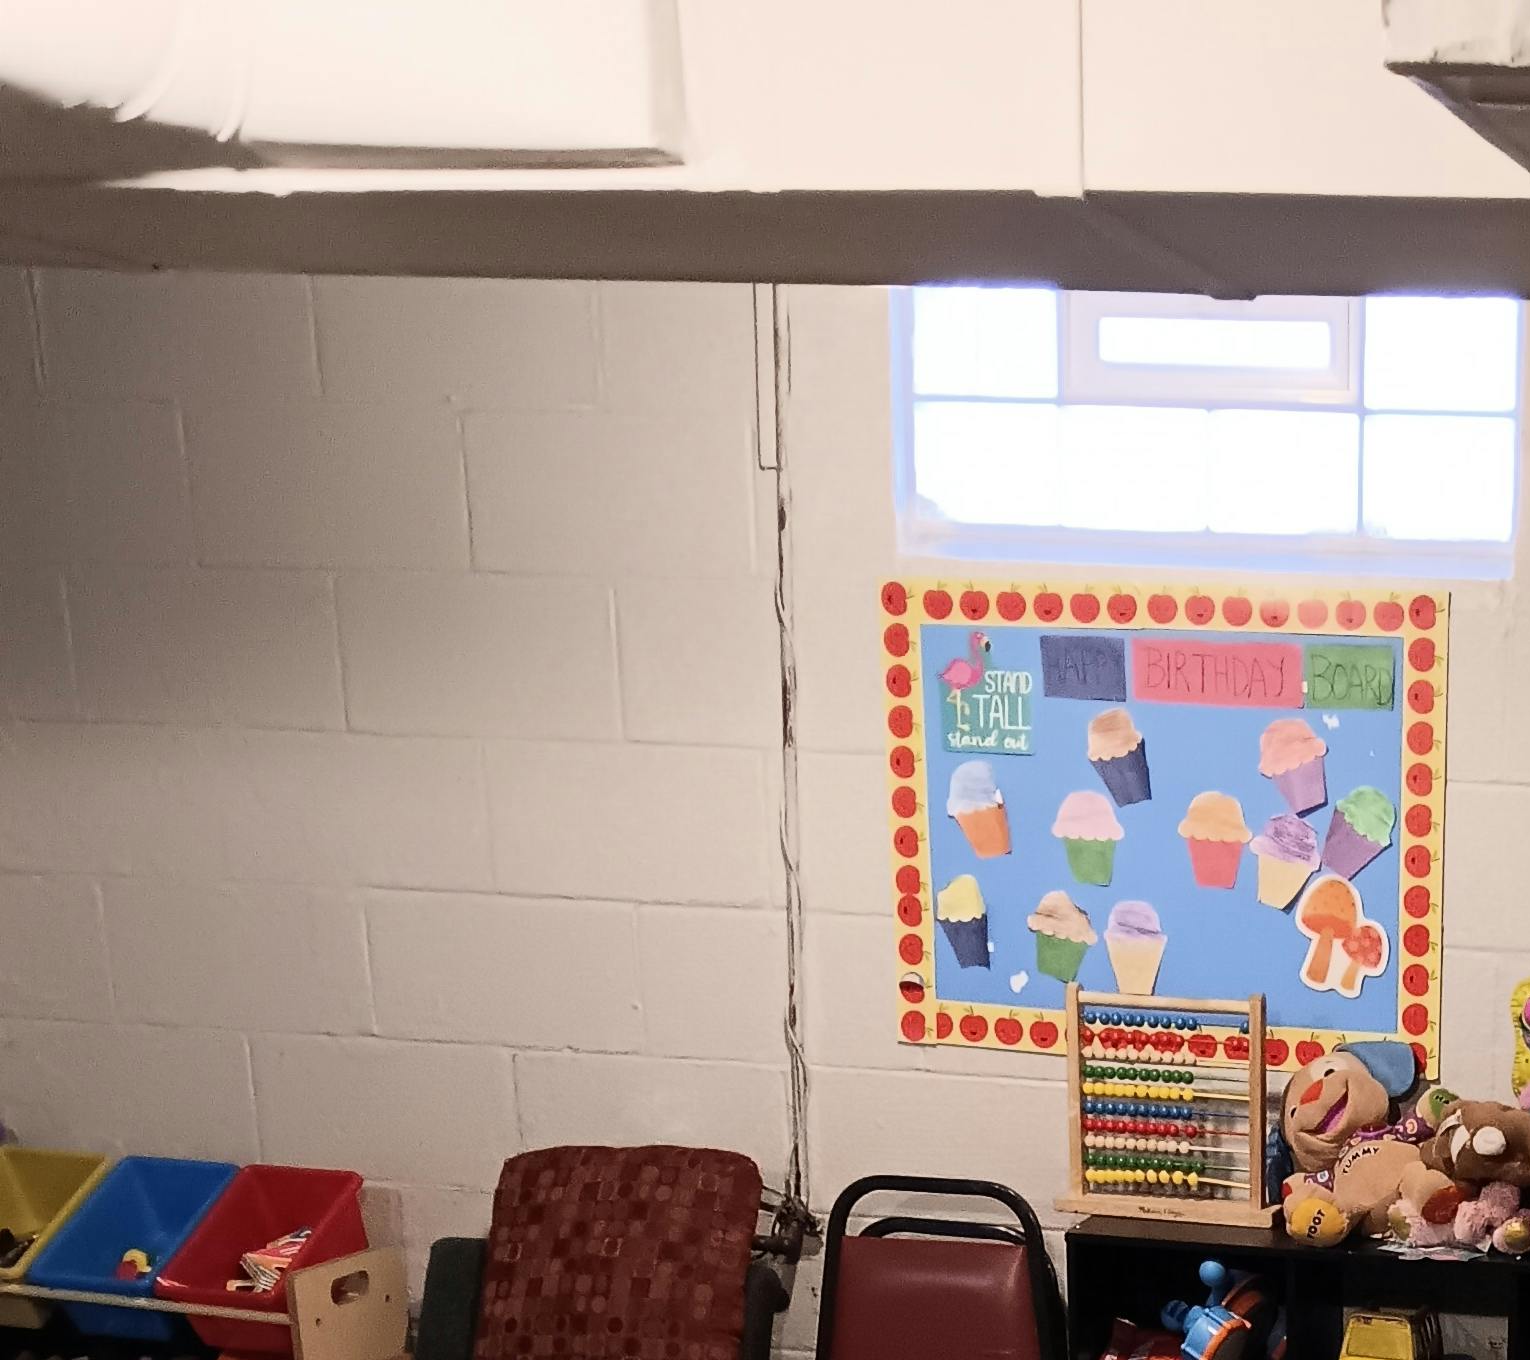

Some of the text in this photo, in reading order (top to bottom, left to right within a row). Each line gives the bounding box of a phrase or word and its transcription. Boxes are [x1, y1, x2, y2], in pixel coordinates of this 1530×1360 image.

[984, 670, 1032, 694] STAND
[1145, 647, 1284, 698] BIRTHDAY
[1310, 654, 1394, 706] BOARD
[972, 693, 1032, 730] TALL
[947, 730, 1028, 751] stand out
[1343, 1147, 1379, 1174] TUMMY
